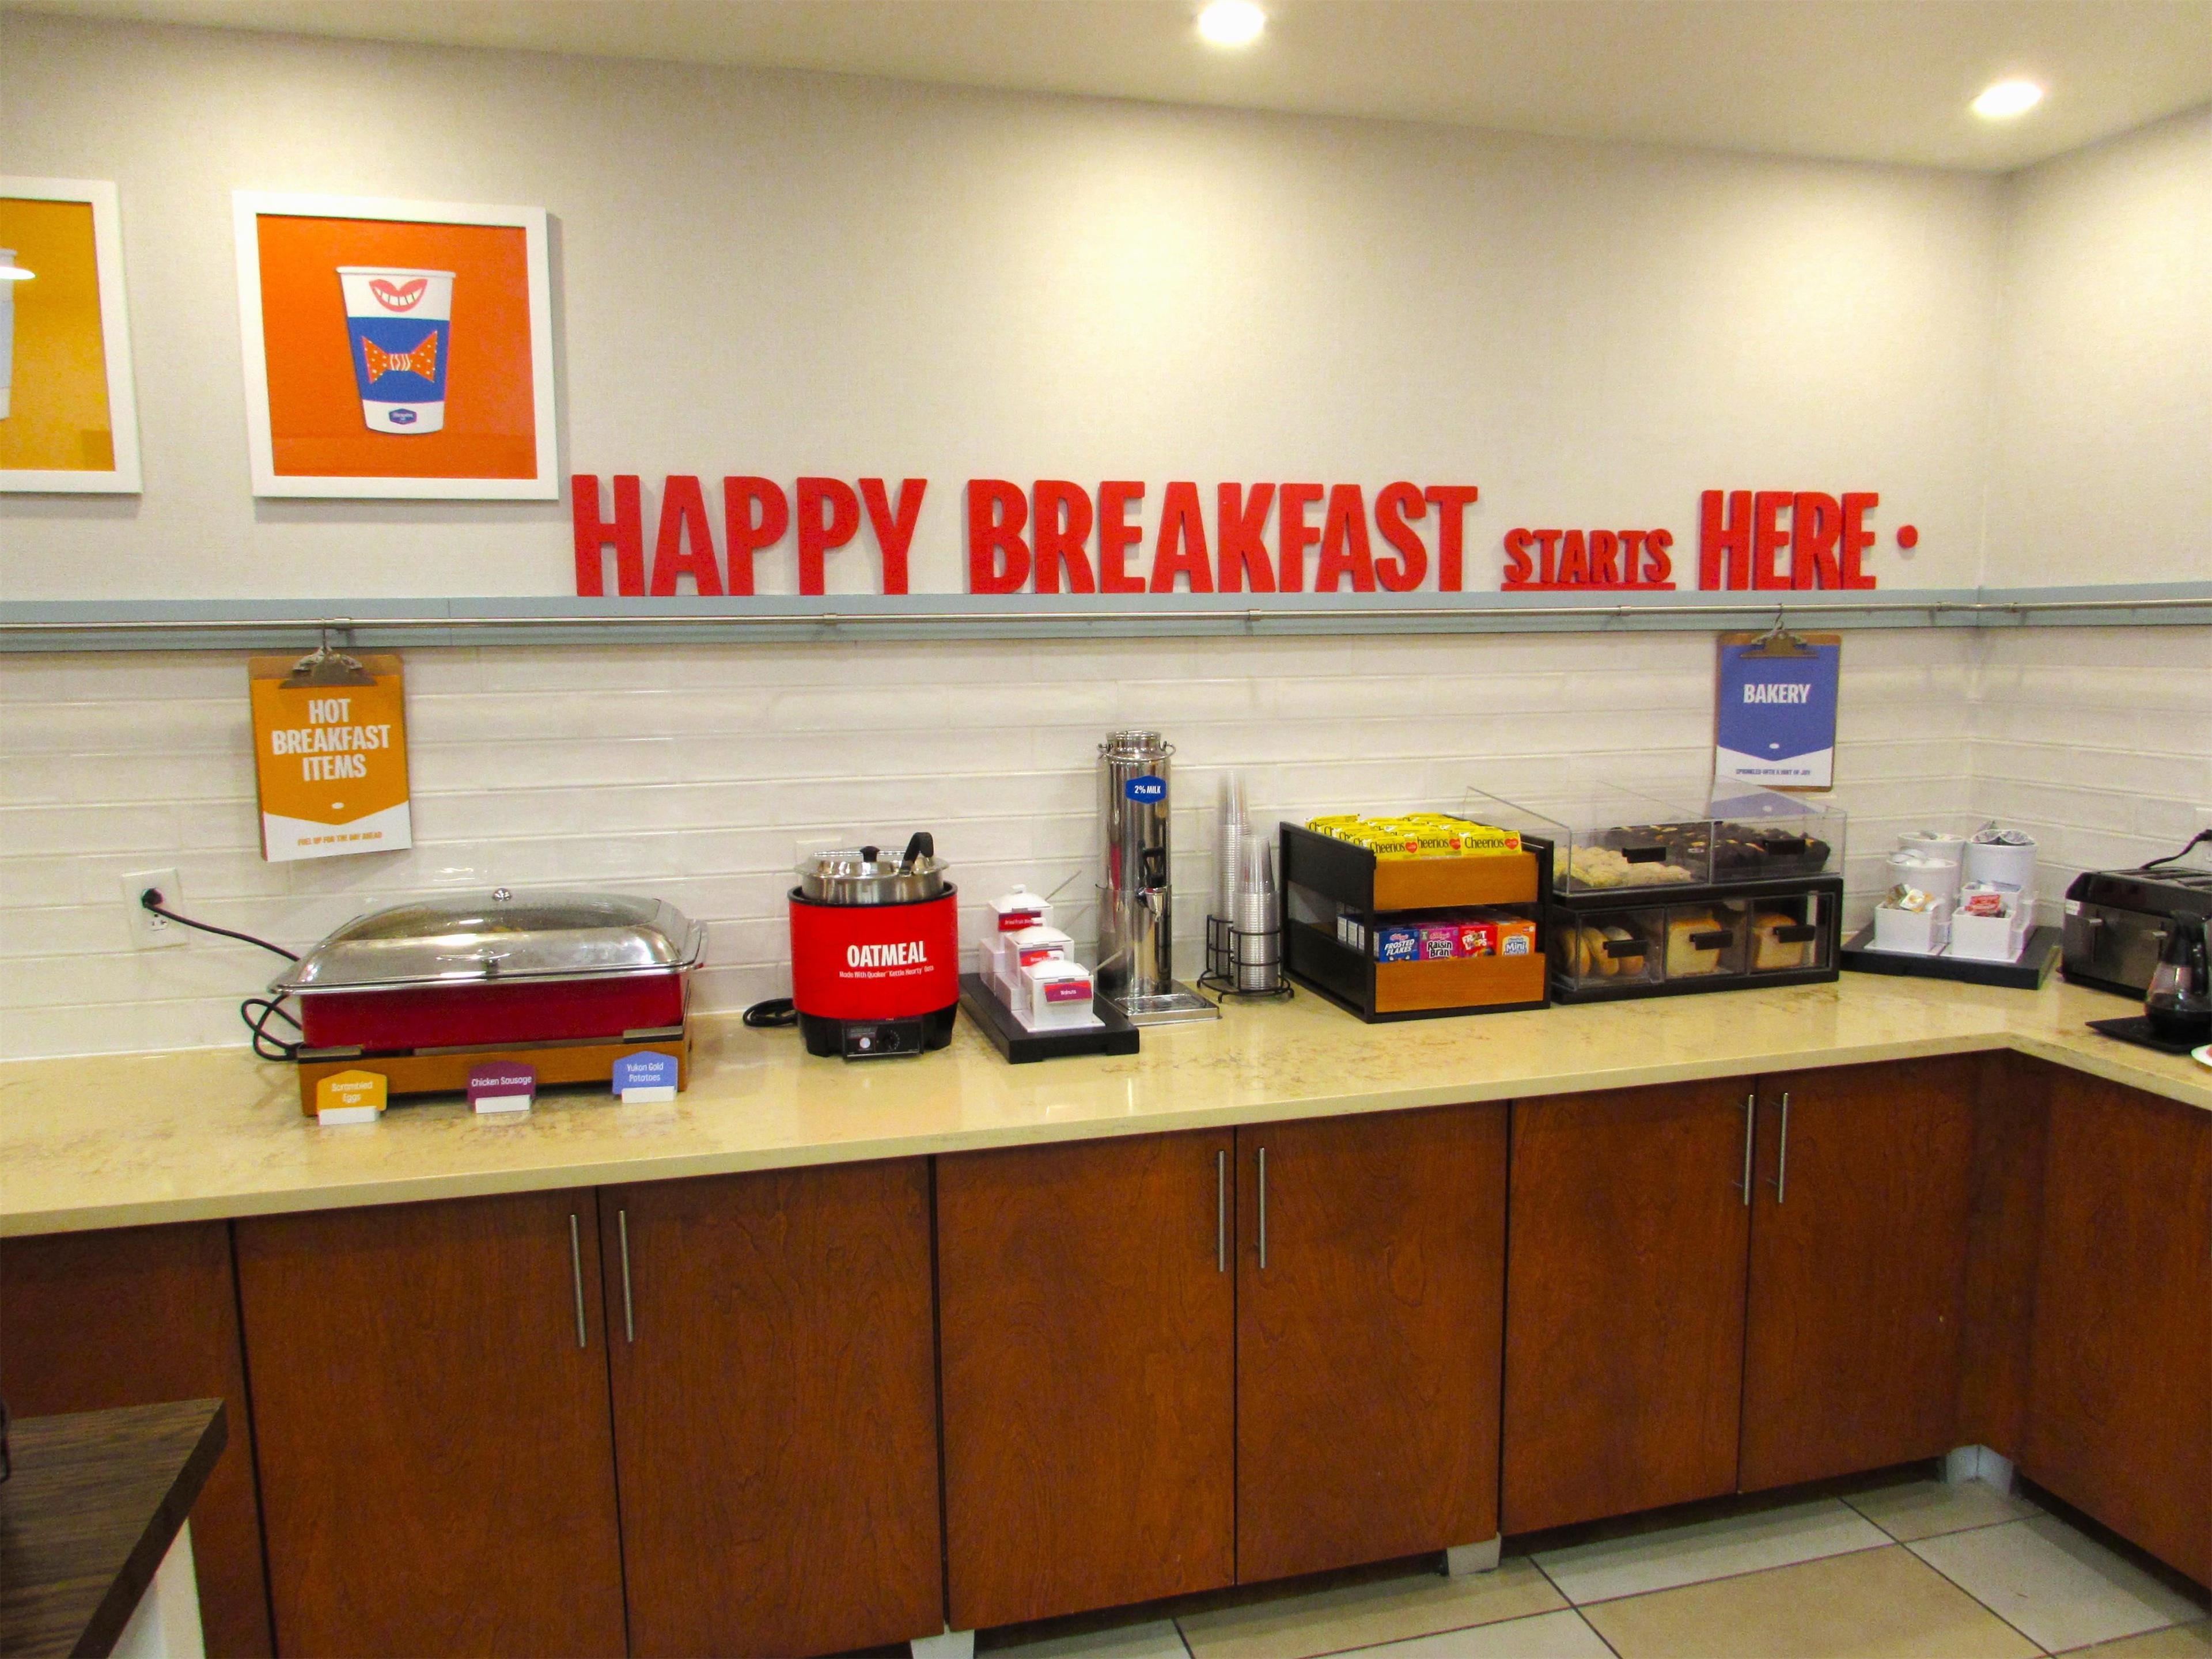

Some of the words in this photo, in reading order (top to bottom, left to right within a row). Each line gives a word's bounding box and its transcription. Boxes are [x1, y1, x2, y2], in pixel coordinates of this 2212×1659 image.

[571, 475, 927, 597] HAPPY
[967, 479, 1478, 594] BREAKFAST
[1502, 528, 1673, 583] STARTS
[1743, 684, 1811, 703] BAKERY
[308, 698, 351, 724] HOT
[272, 725, 391, 755] BREAKFAST
[302, 753, 366, 781] ITEMS
[1134, 785, 1146, 794] 2%
[1146, 786, 1161, 794] MILK
[1370, 841, 1406, 854] Cheerios
[1416, 836, 1449, 849] heerios
[1464, 836, 1505, 849] Cheerios
[1384, 939, 1415, 950] FROSTED
[1427, 940, 1453, 952] Raisin
[1505, 942, 1526, 952] Mini
[847, 940, 927, 967] OATMEAL
[1386, 946, 1412, 956] FLAKES
[1429, 948, 1449, 958] Bran
[627, 1063, 647, 1071] Yukon
[648, 1062, 664, 1071] Gold
[472, 1078, 499, 1087] Chicken
[500, 1076, 532, 1085] Sausage
[629, 1073, 661, 1082] Potatoes
